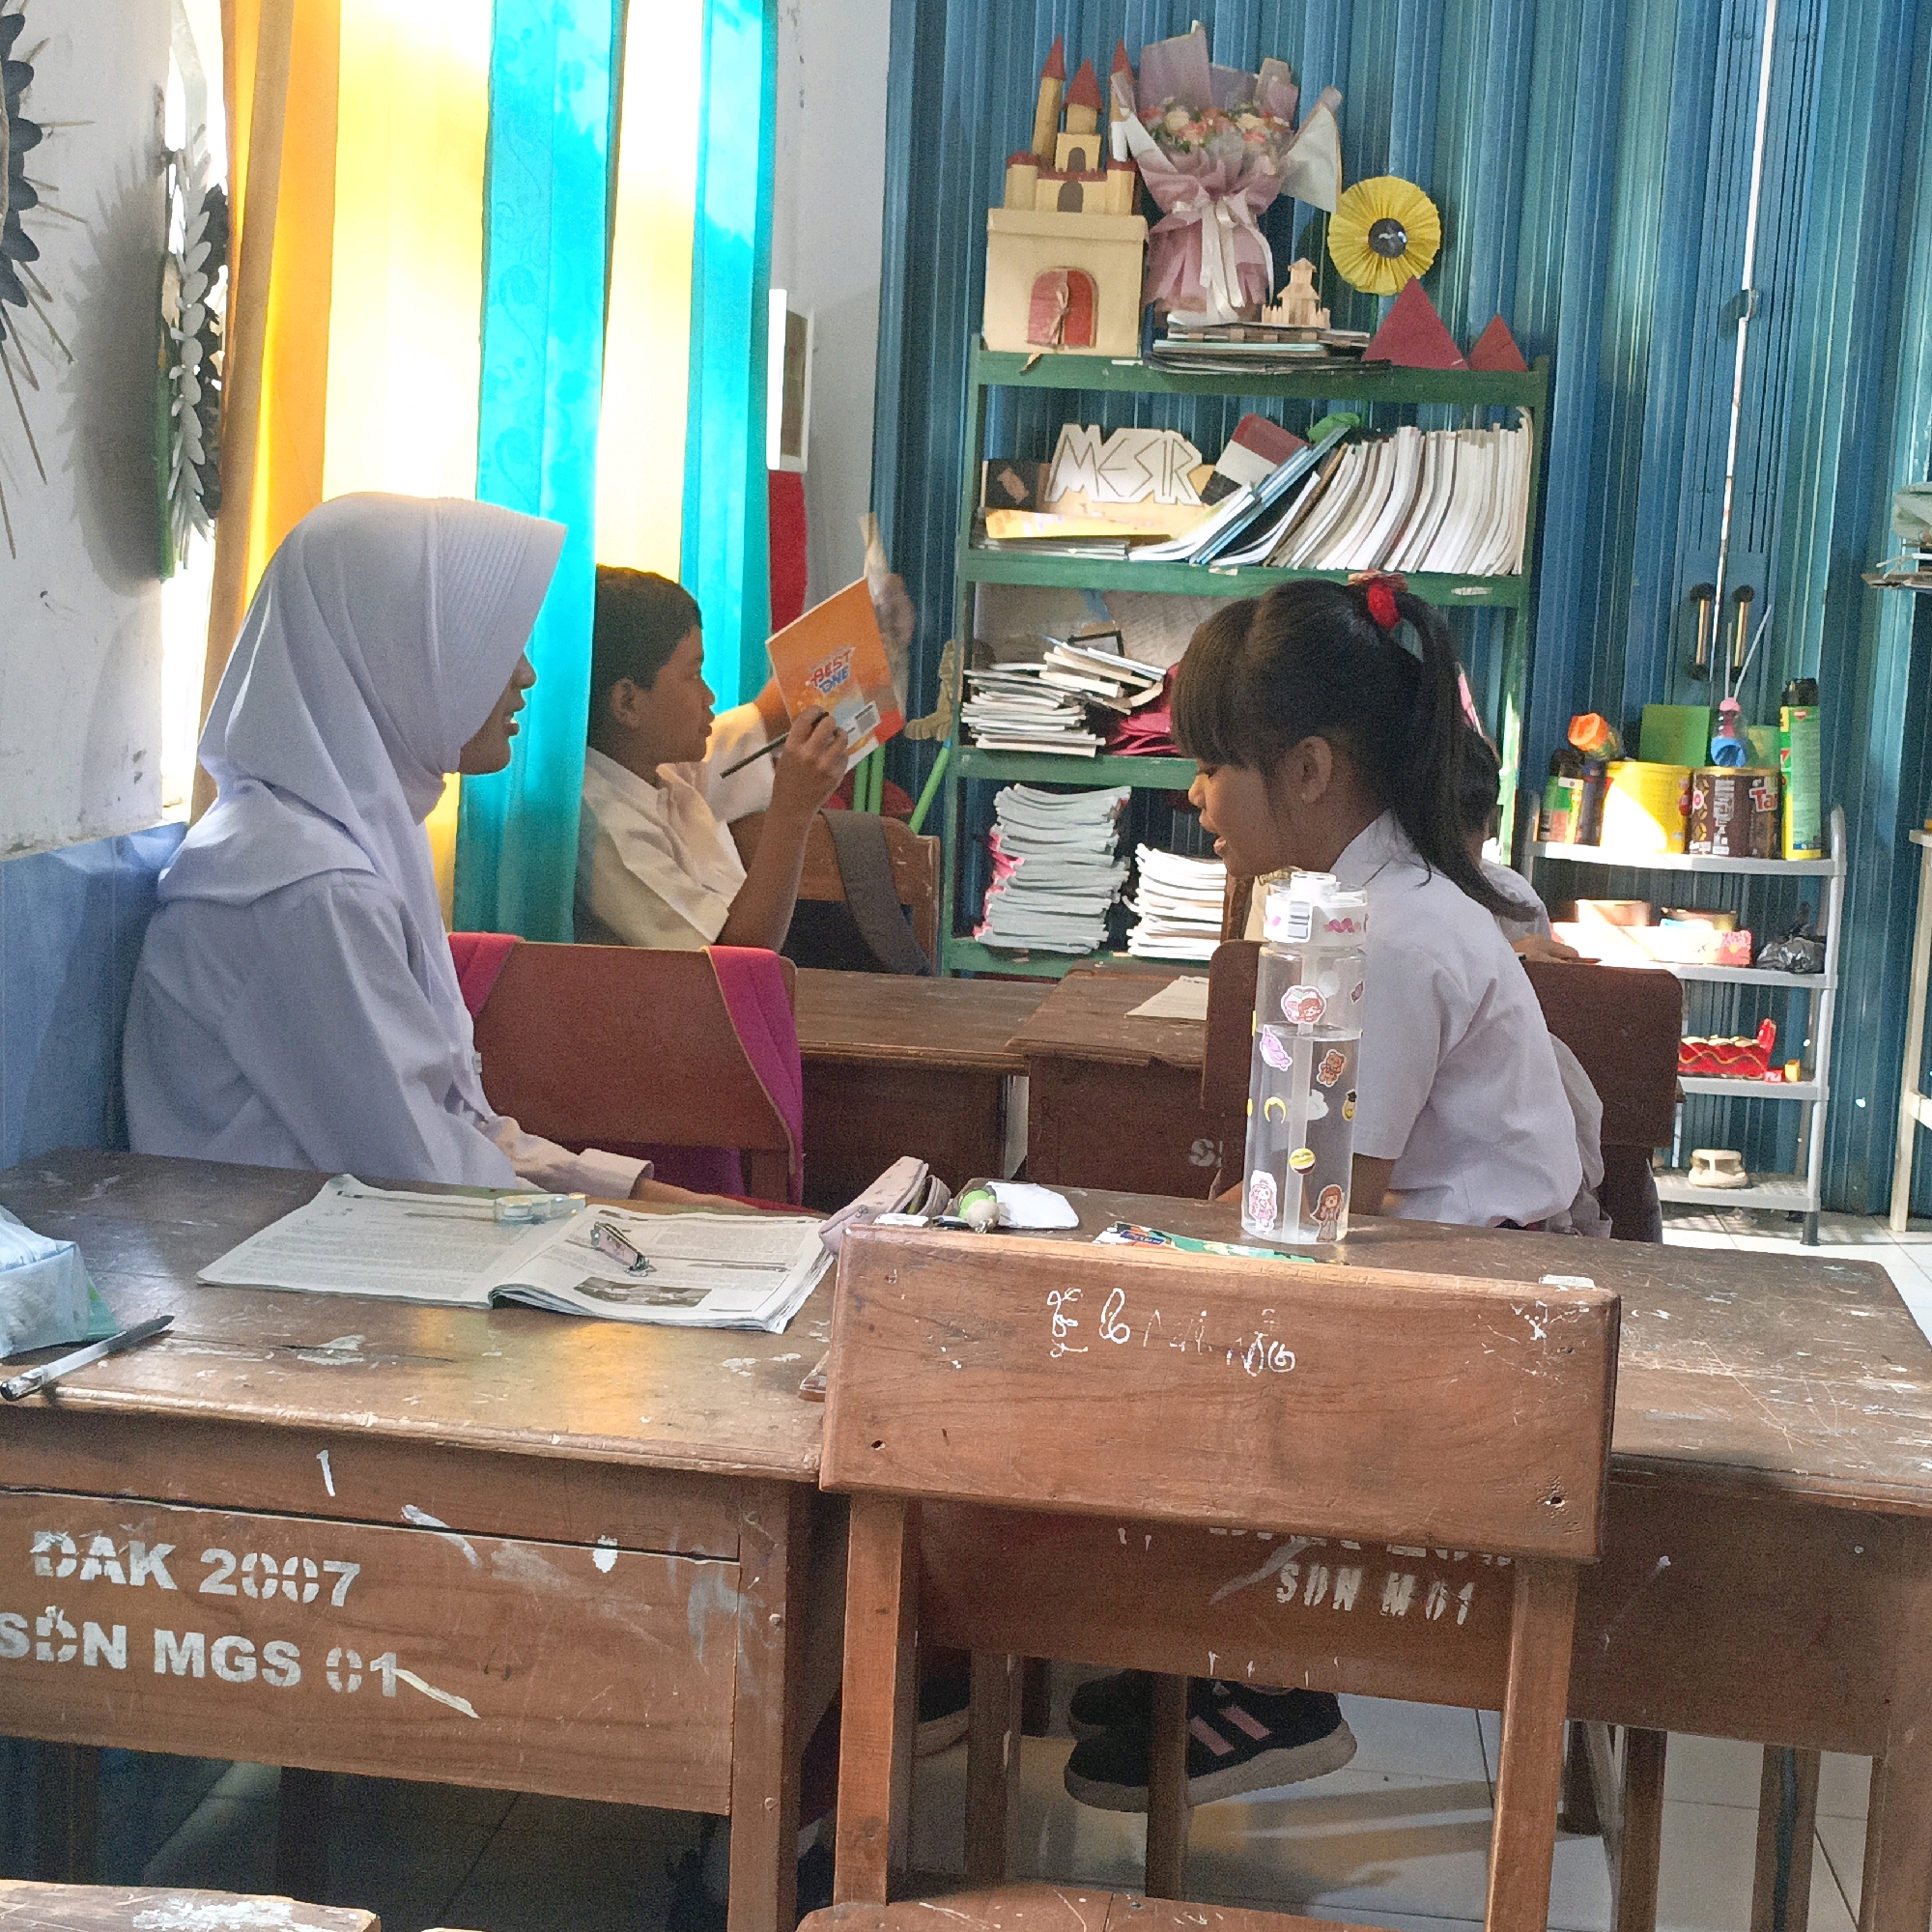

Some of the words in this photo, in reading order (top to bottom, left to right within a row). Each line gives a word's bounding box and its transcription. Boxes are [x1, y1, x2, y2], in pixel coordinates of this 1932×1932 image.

[813, 649, 853, 686] BEST
[818, 665, 849, 694] ONE
[1750, 788, 1777, 810] Ta
[32, 1531, 179, 1591] DAK
[199, 1548, 361, 1607] 2007
[0, 1608, 128, 1670] SDN
[154, 1628, 302, 1688] MGS
[326, 1646, 397, 1697] 01
